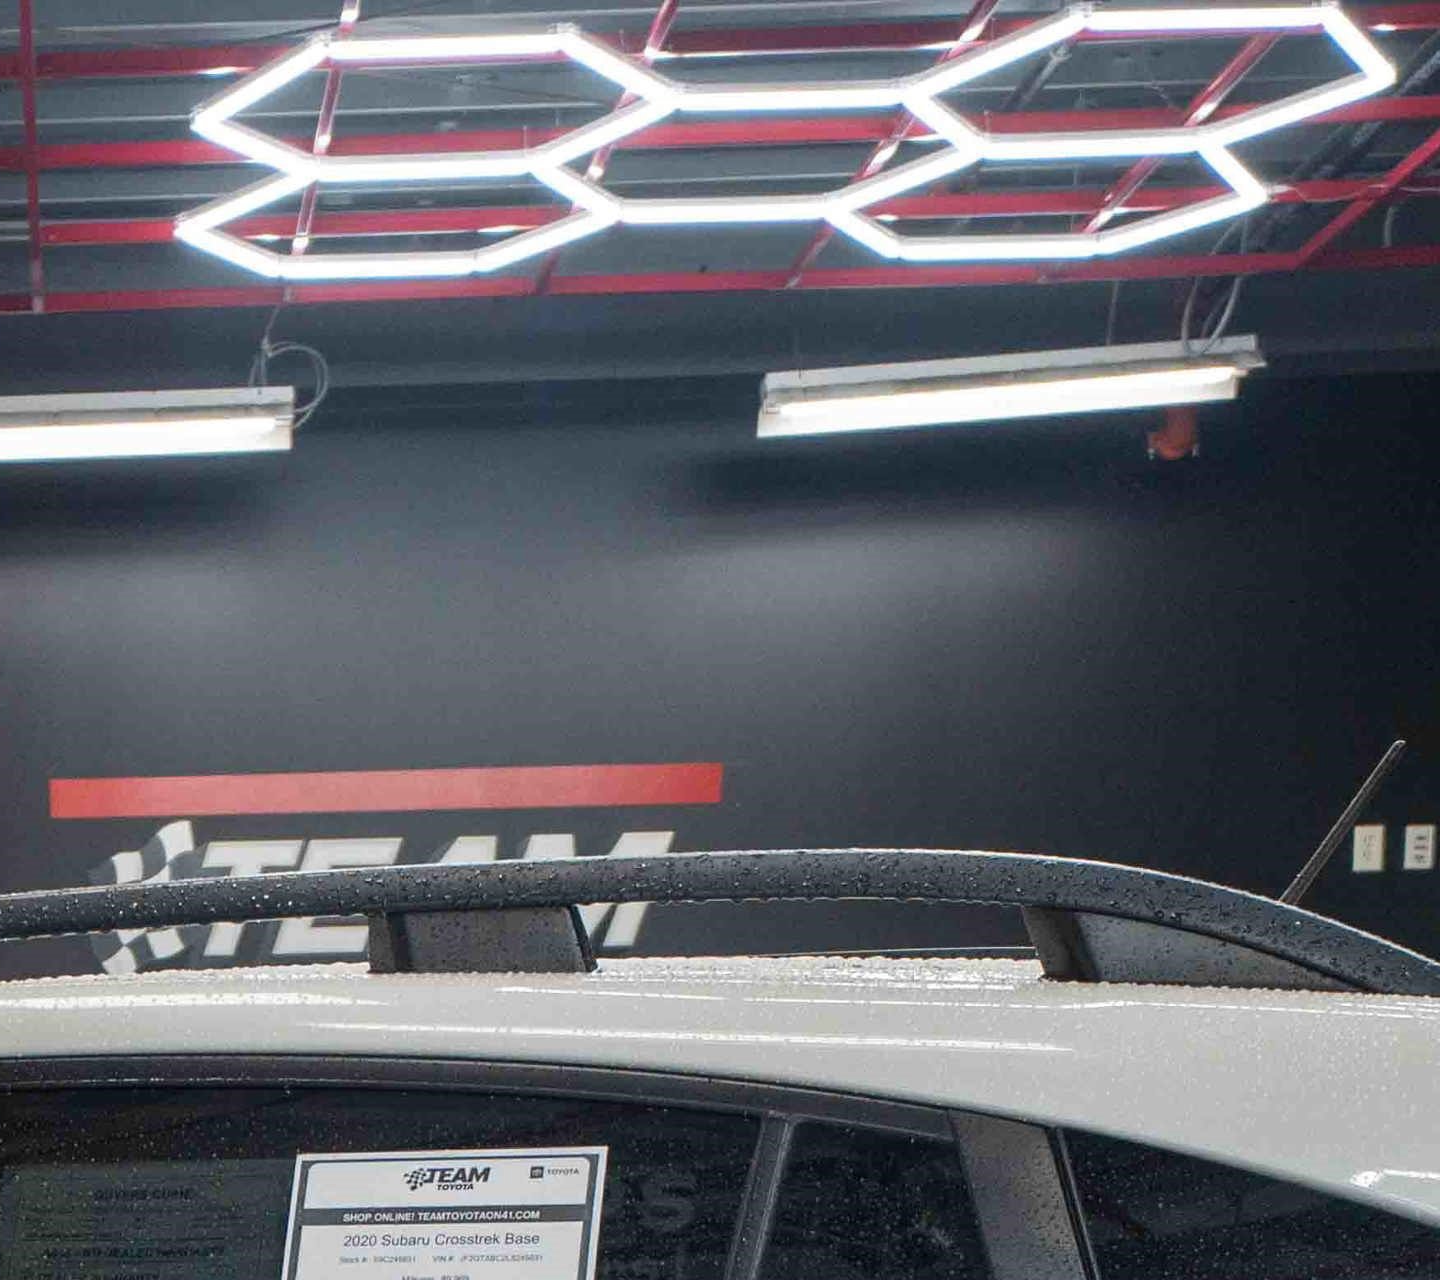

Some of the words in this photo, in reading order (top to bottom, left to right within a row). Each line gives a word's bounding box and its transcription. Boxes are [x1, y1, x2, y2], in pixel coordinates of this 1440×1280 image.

[201, 829, 676, 957] TEM
[422, 1167, 492, 1184] TEAM
[546, 1167, 580, 1176] TOYOTA
[436, 1183, 475, 1192] TOYOTA
[342, 1212, 372, 1223] SHOP
[374, 1211, 415, 1222] ONLINE!
[418, 1210, 541, 1222] TEAMTOYOTAON41.COM
[343, 1235, 377, 1247] 2020
[381, 1234, 430, 1247] Subaru
[434, 1233, 500, 1246] Crosstrek
[504, 1233, 541, 1245] Base
